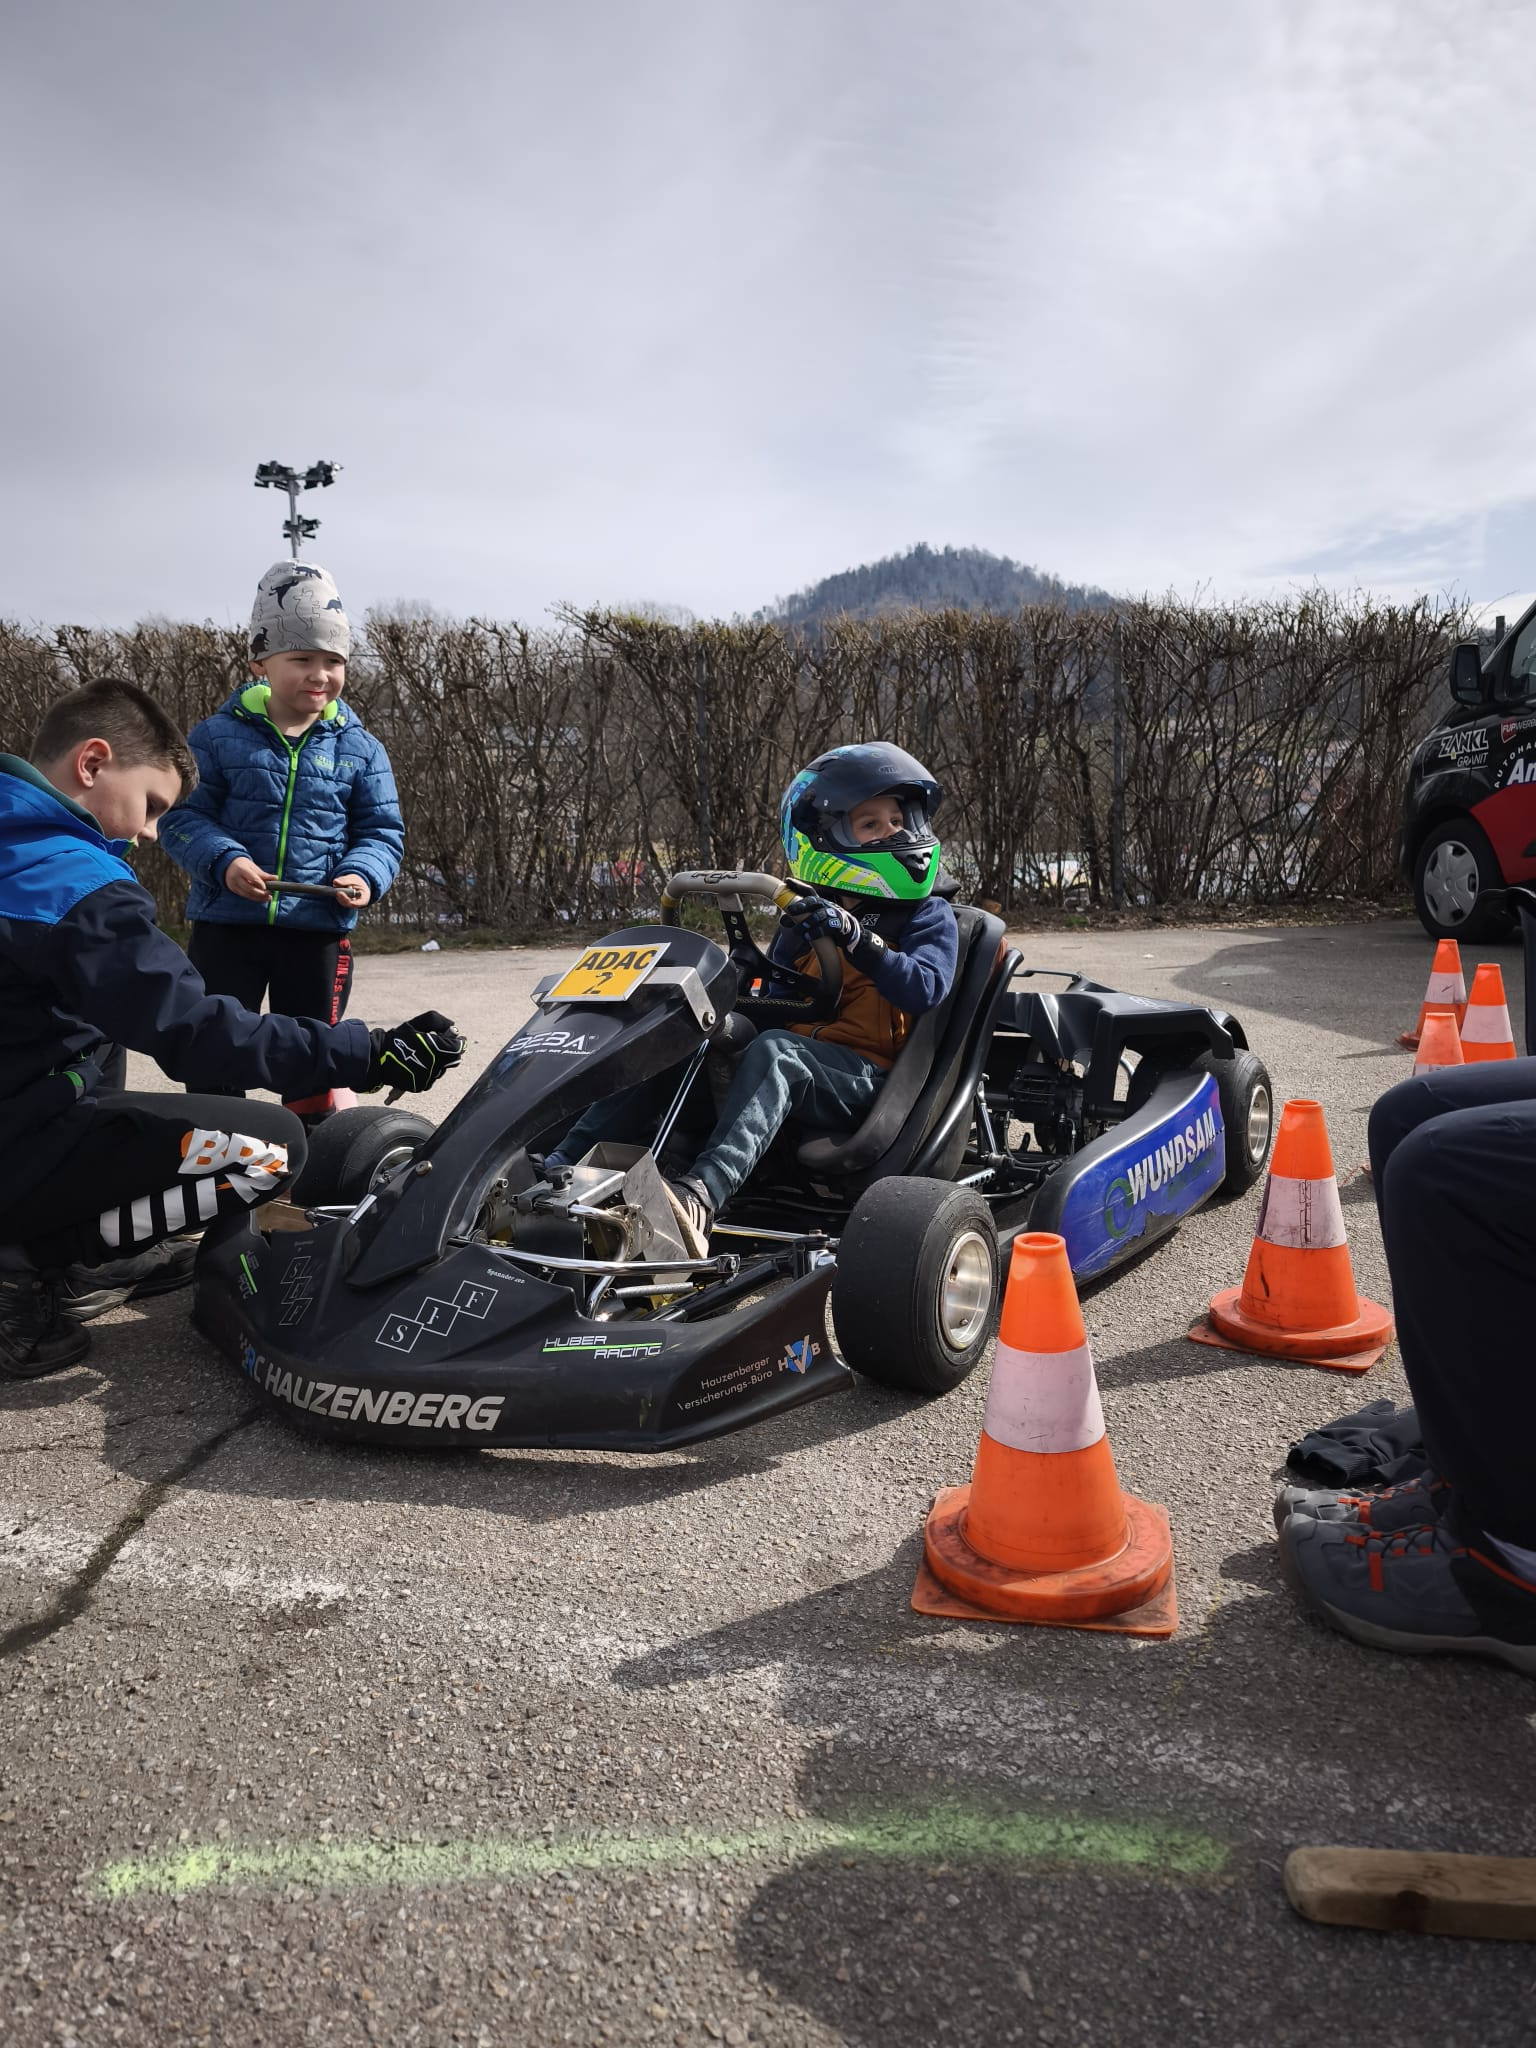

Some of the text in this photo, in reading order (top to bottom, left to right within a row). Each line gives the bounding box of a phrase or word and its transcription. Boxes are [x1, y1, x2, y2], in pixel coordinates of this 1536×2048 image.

[1439, 728, 1489, 758] ZANKL
[1457, 752, 1488, 768] GRANIT
[1494, 742, 1536, 788] AUTOHA
[575, 949, 658, 971] ADAC
[582, 971, 614, 995] 2
[544, 1335, 608, 1349] HUBER
[593, 1345, 662, 1360] RACING
[700, 1355, 771, 1390] Hauzenberger
[264, 1362, 506, 1431] HAUZENBERG
